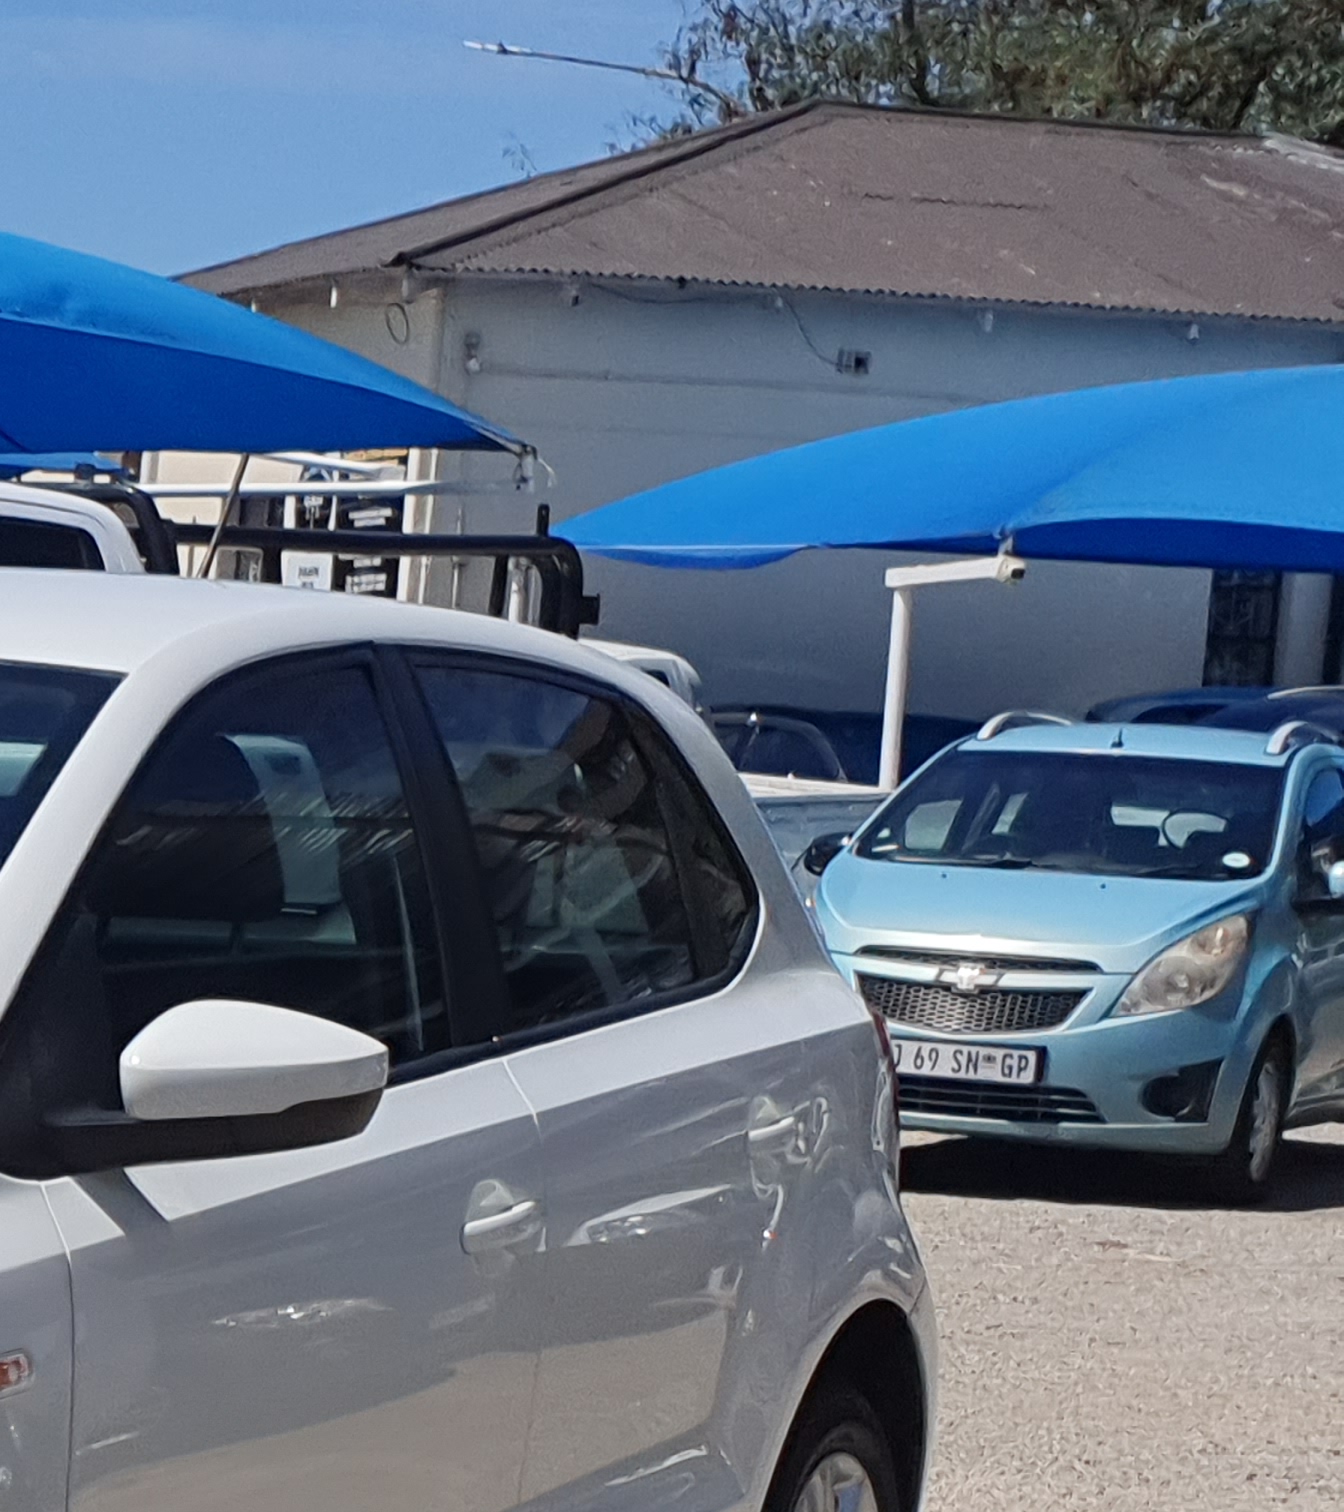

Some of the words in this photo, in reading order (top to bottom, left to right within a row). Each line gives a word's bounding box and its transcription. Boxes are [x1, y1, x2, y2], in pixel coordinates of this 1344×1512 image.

[913, 1046, 940, 1072] 69
[950, 1049, 980, 1076] SN
[1000, 1053, 1030, 1079] GP
